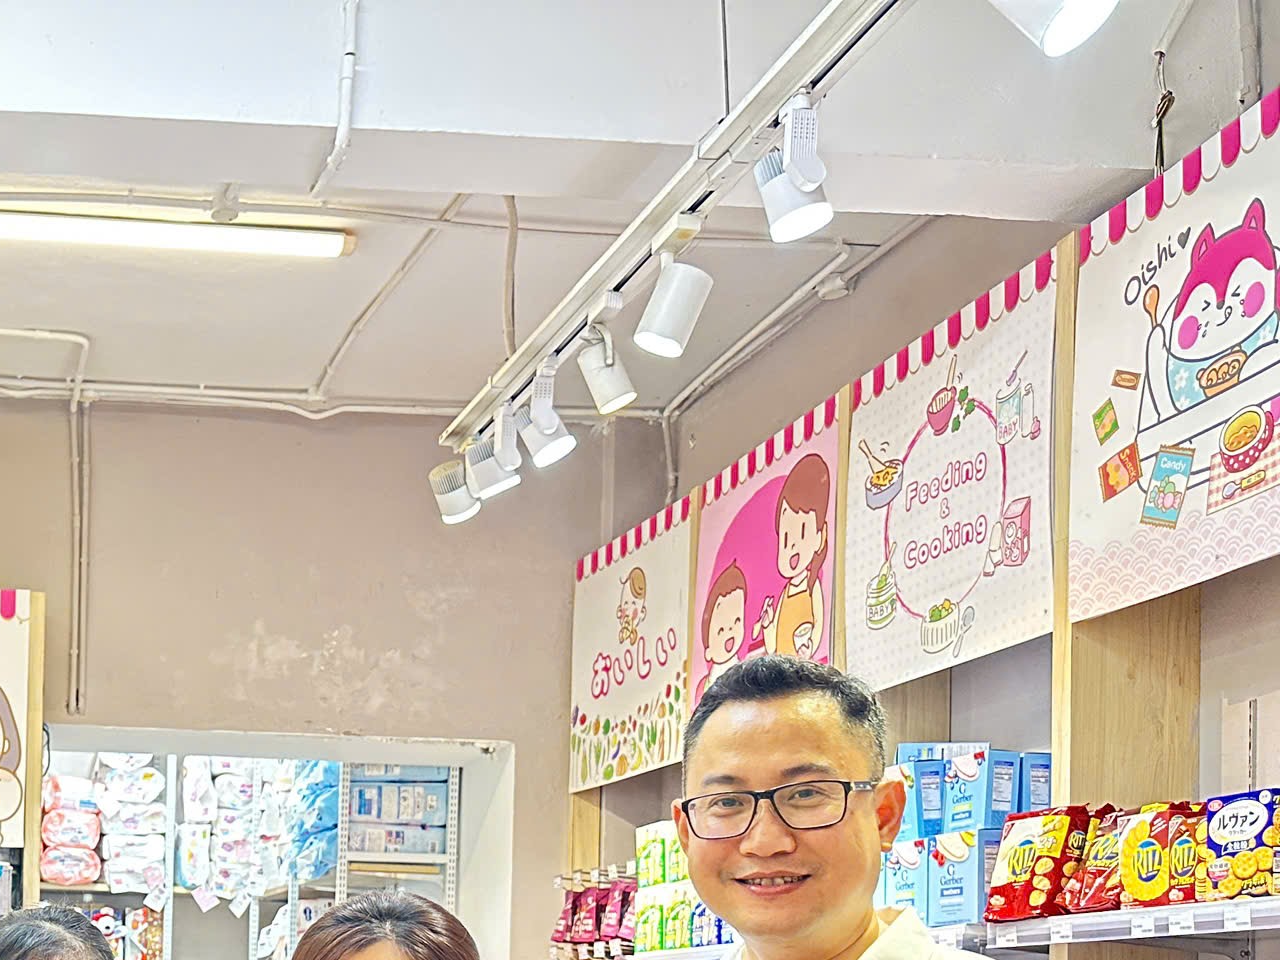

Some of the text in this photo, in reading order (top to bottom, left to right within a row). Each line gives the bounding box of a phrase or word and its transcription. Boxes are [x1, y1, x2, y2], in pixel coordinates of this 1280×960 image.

[1125, 234, 1177, 306] Oishi
[998, 421, 1018, 439] BABY
[1160, 457, 1187, 473] Candy
[905, 451, 988, 512] Feeding
[939, 497, 950, 519] &
[903, 514, 988, 569] Cooking
[869, 605, 889, 619] BABY
[591, 627, 677, 699] おいしい
[952, 794, 973, 805] Gerber
[1217, 811, 1260, 831] ルヴァン
[1008, 842, 1038, 876] RITZ
[1133, 847, 1162, 879] RITZ
[1171, 845, 1197, 876] RITZ
[895, 881, 915, 891] Gerber
[940, 876, 964, 886] Gerber
